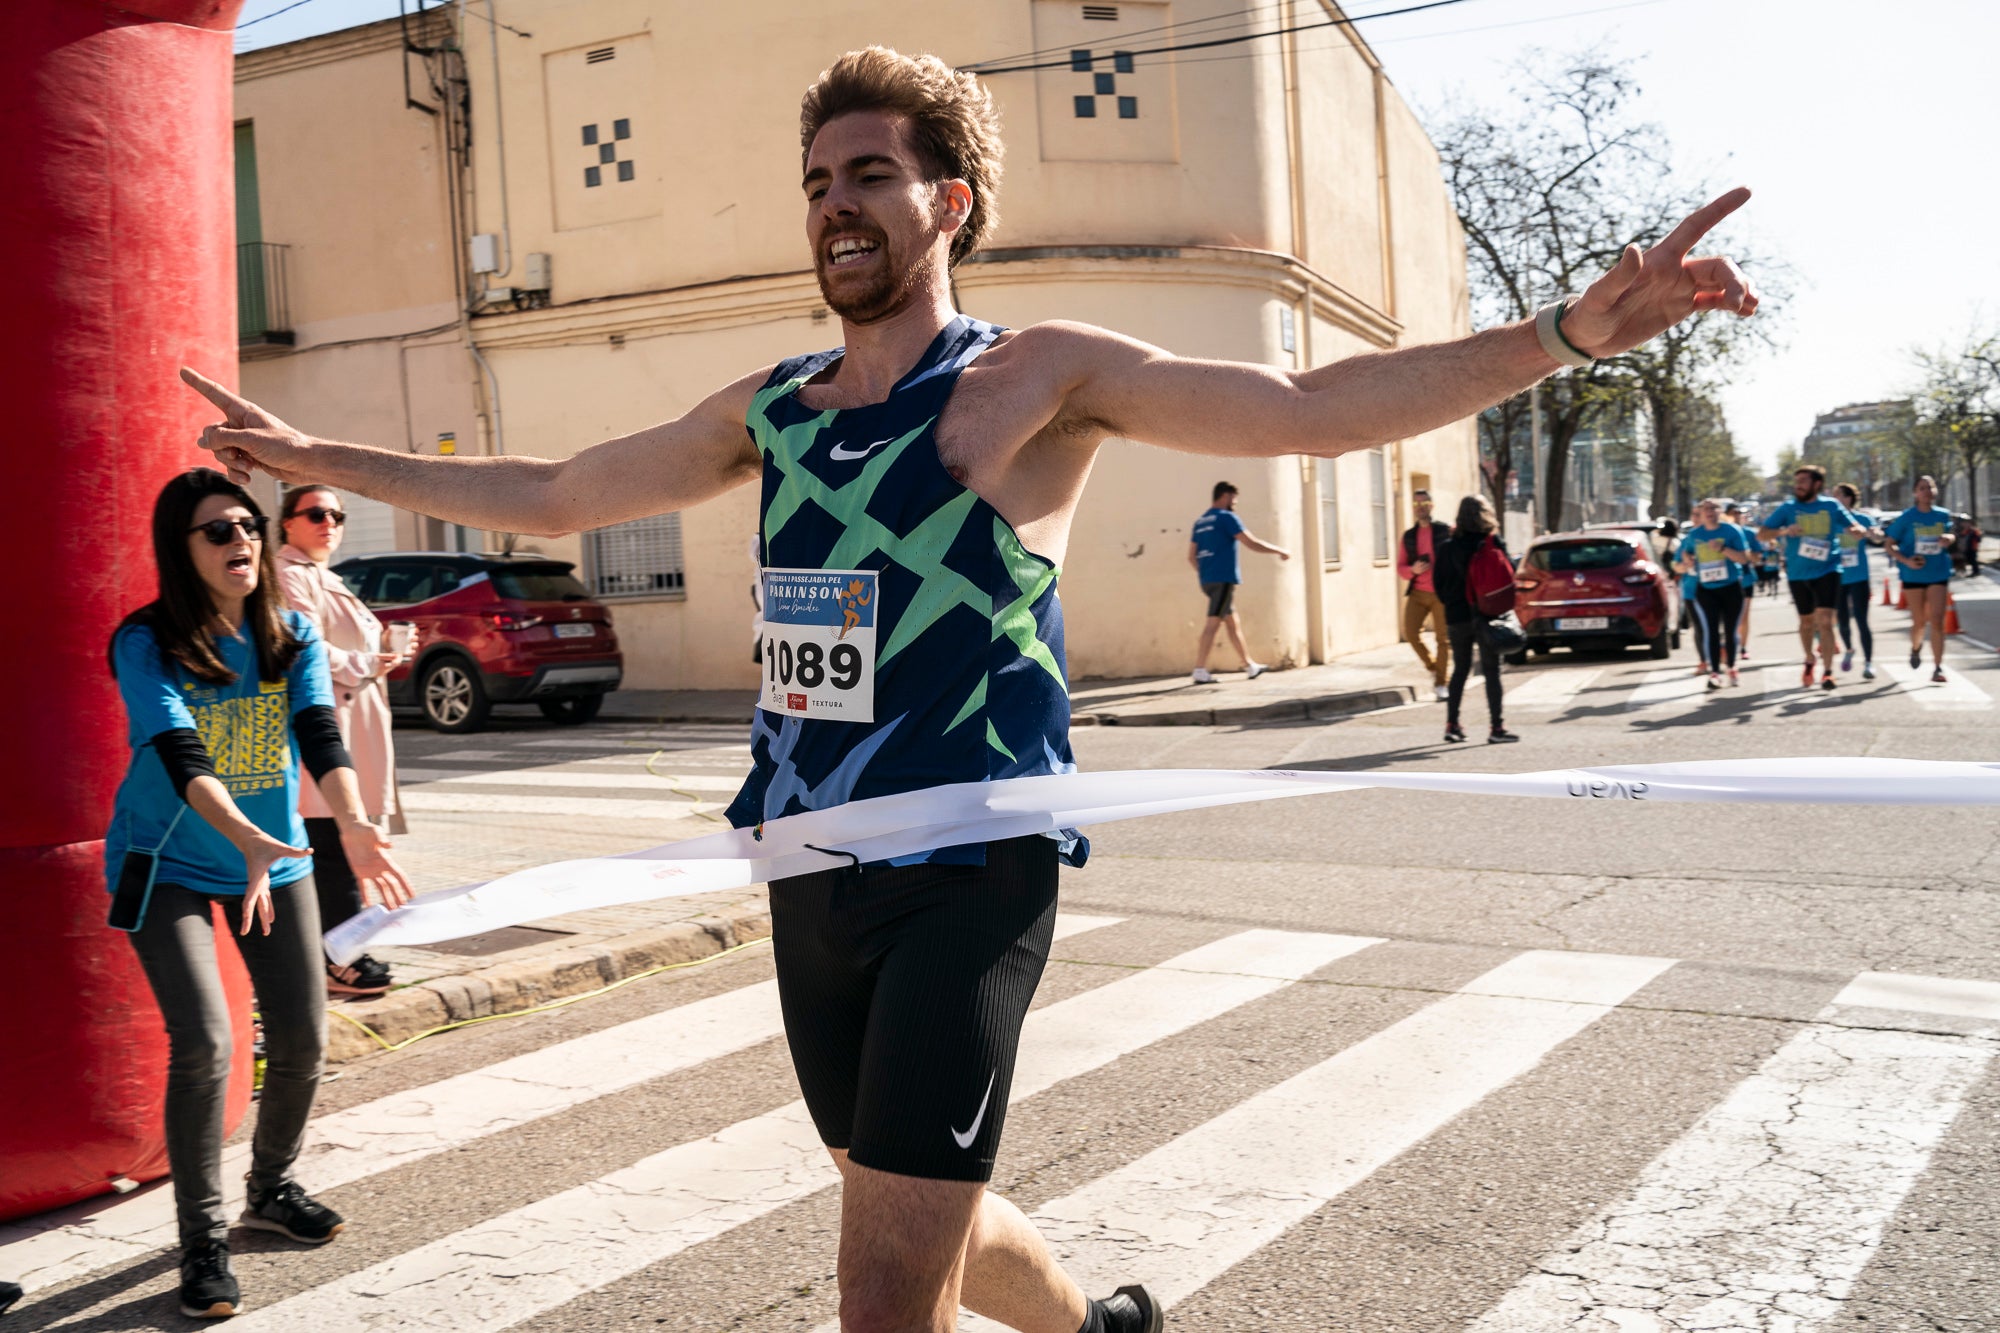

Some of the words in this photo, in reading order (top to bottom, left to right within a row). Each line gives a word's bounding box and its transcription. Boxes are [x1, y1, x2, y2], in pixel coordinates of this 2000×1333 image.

[791, 575, 826, 583] PASSEJADA
[769, 585, 843, 599] PARKINSON
[767, 637, 862, 691] 1089
[812, 700, 843, 708] TEXTURA
